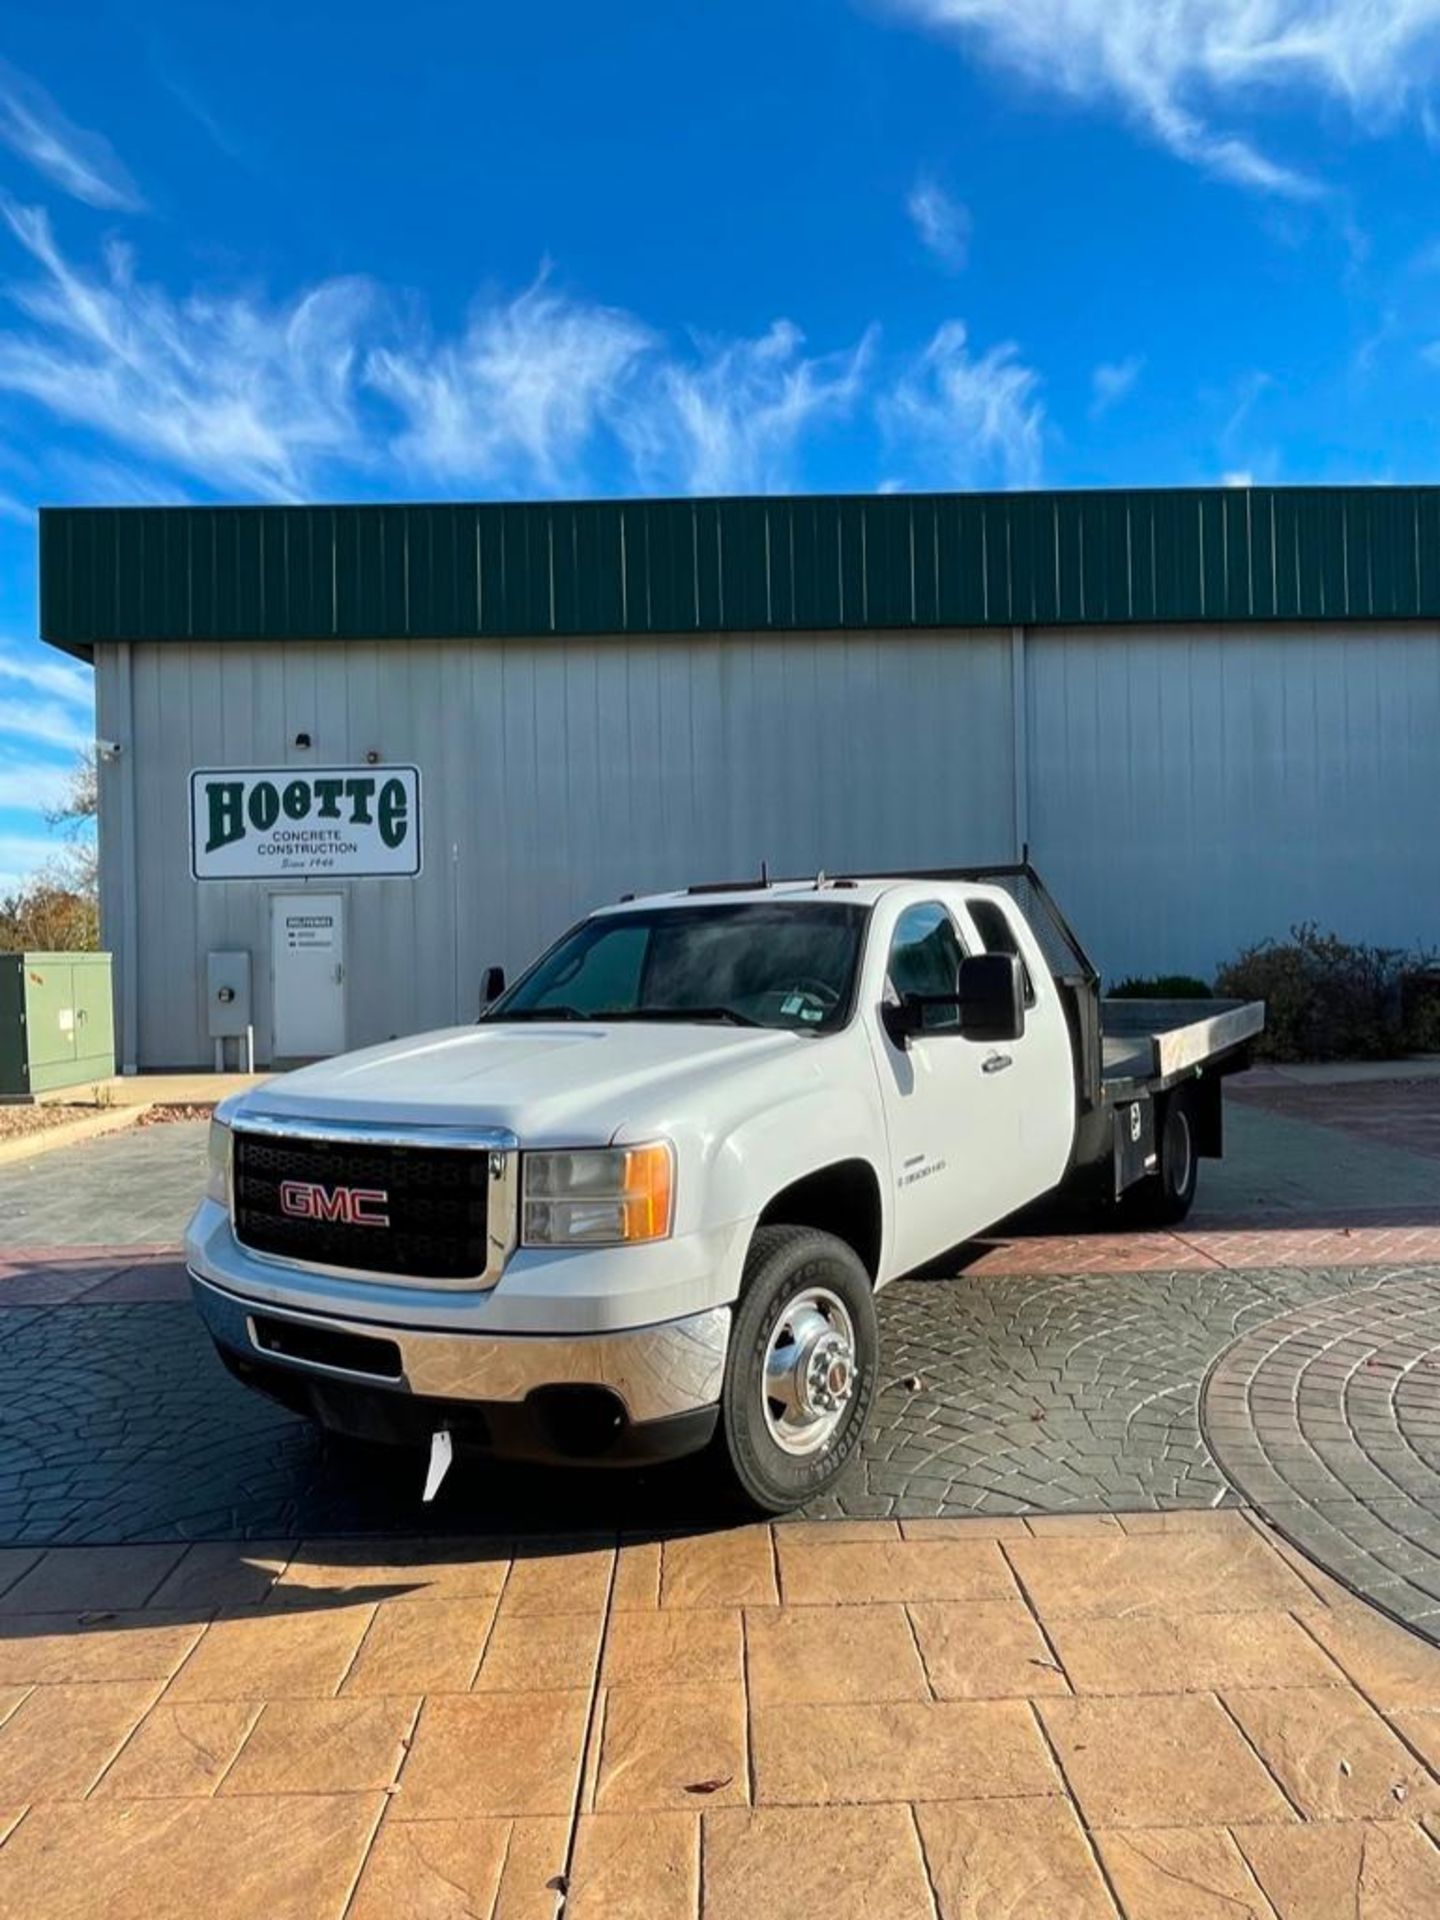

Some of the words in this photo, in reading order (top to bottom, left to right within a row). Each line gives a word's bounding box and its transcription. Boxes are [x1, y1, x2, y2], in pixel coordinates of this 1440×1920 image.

[272, 830, 342, 842] CONCRETE
[257, 842, 358, 855] CONSTRUCTION
[281, 858, 305, 869] Since
[279, 1179, 391, 1228] GMC
